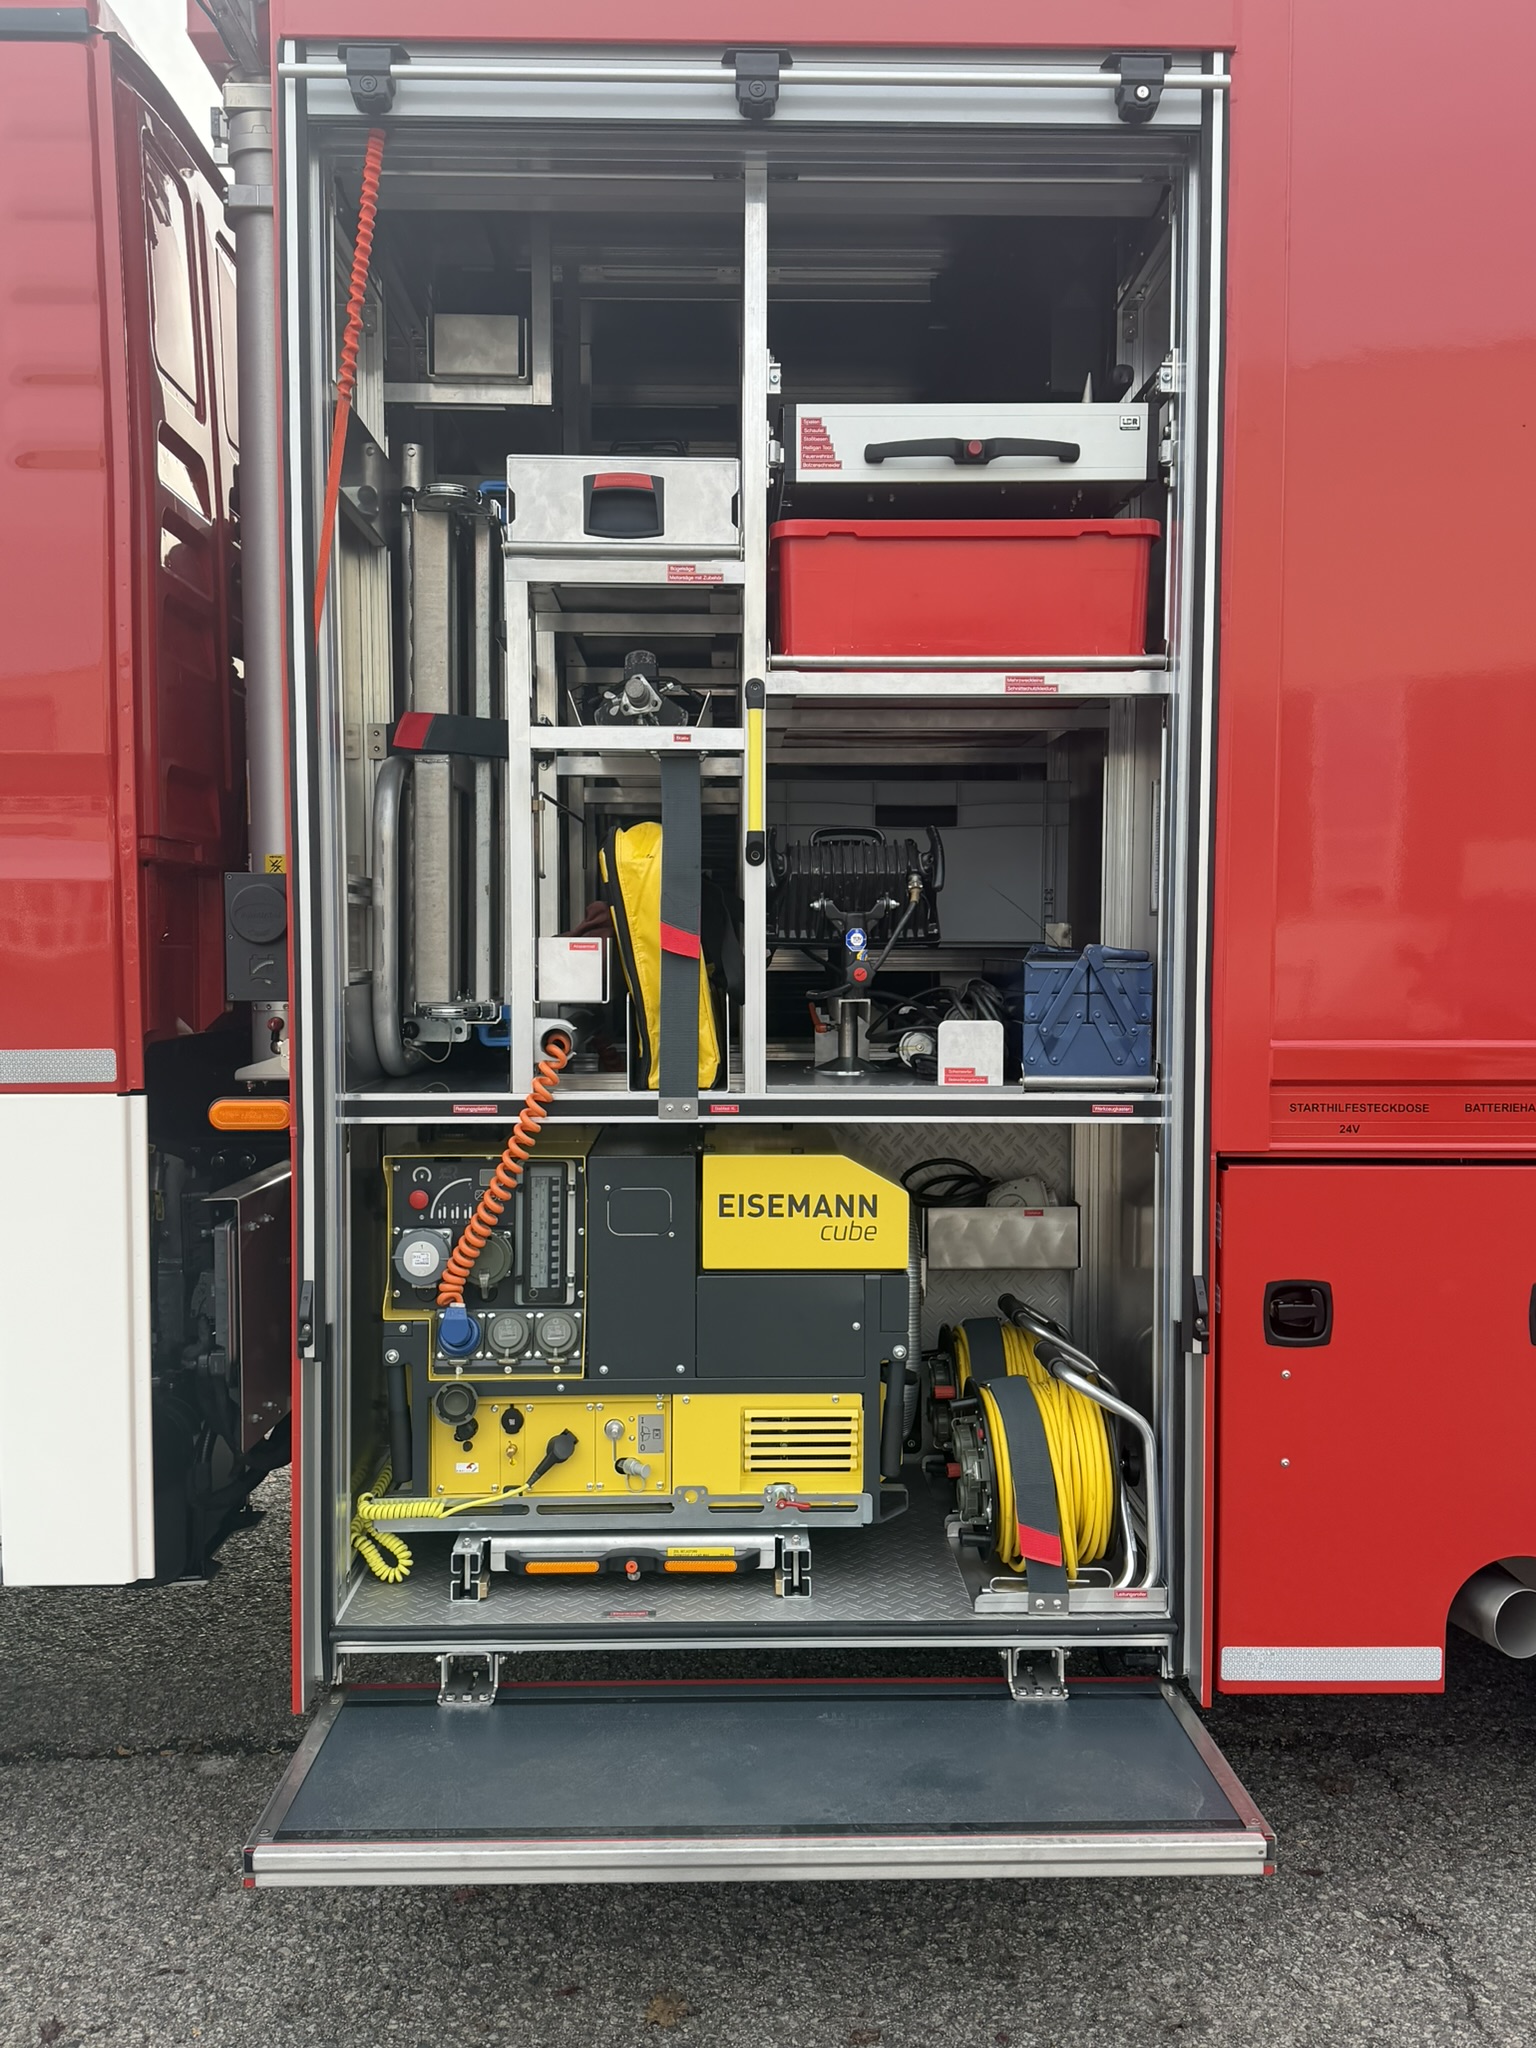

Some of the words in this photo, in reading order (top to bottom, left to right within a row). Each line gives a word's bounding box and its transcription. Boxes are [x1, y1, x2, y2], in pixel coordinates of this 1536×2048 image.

[1289, 1103, 1430, 1113] STARTHILFESTECKDOSE
[1464, 1103, 1536, 1113] BATTERIEHA
[1339, 1124, 1361, 1134] 24V
[718, 1193, 878, 1218] EISEMANN
[820, 1220, 878, 1241] cube
